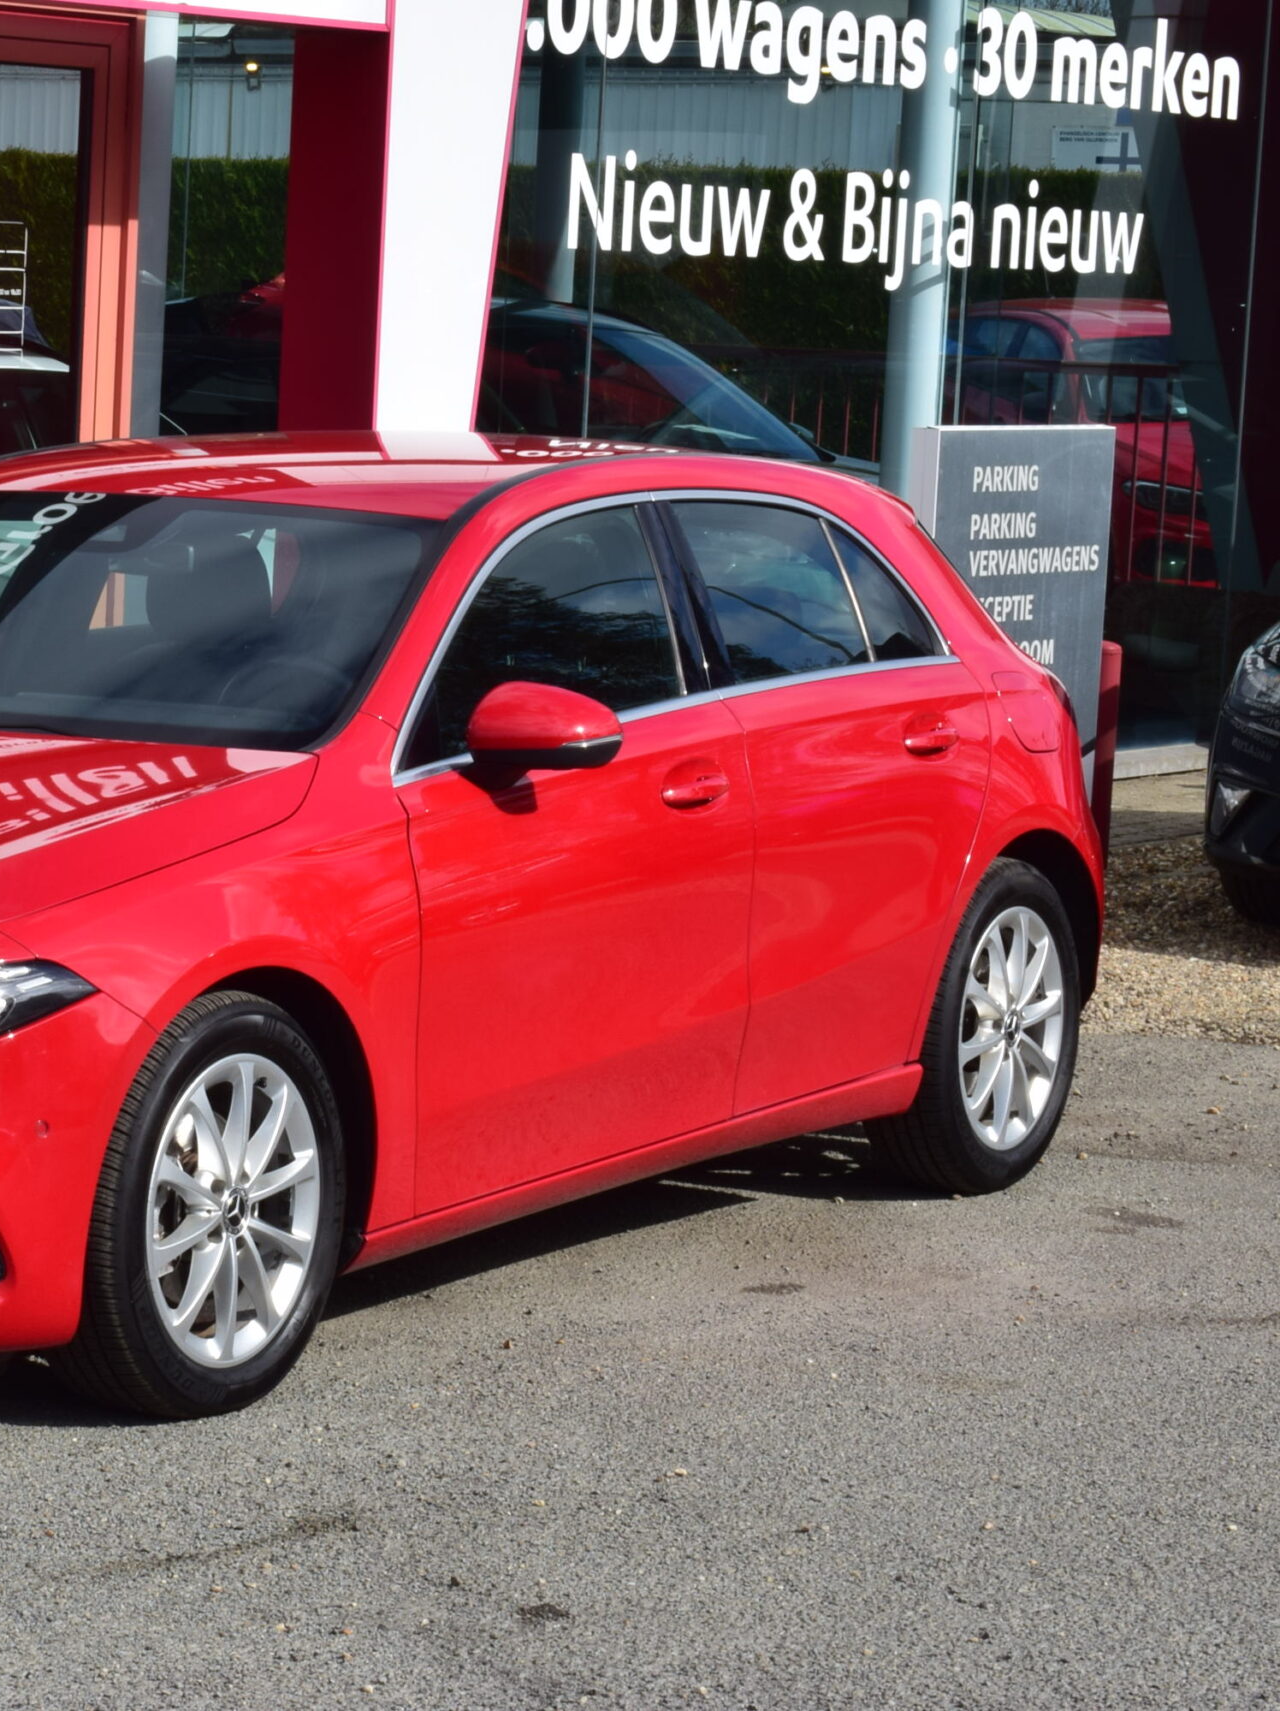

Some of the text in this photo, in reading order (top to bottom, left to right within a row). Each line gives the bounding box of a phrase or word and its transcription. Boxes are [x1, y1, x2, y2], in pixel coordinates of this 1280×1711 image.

[973, 7, 1037, 99] 30
[1051, 19, 1240, 120] merken
[567, 150, 1144, 291] Nieuw & Bijna nieuw
[972, 464, 1040, 493] PARKING
[970, 512, 1037, 540] PARKING
[969, 544, 1100, 578] VERVANGWAGENS
[1014, 638, 1055, 665] OOM
